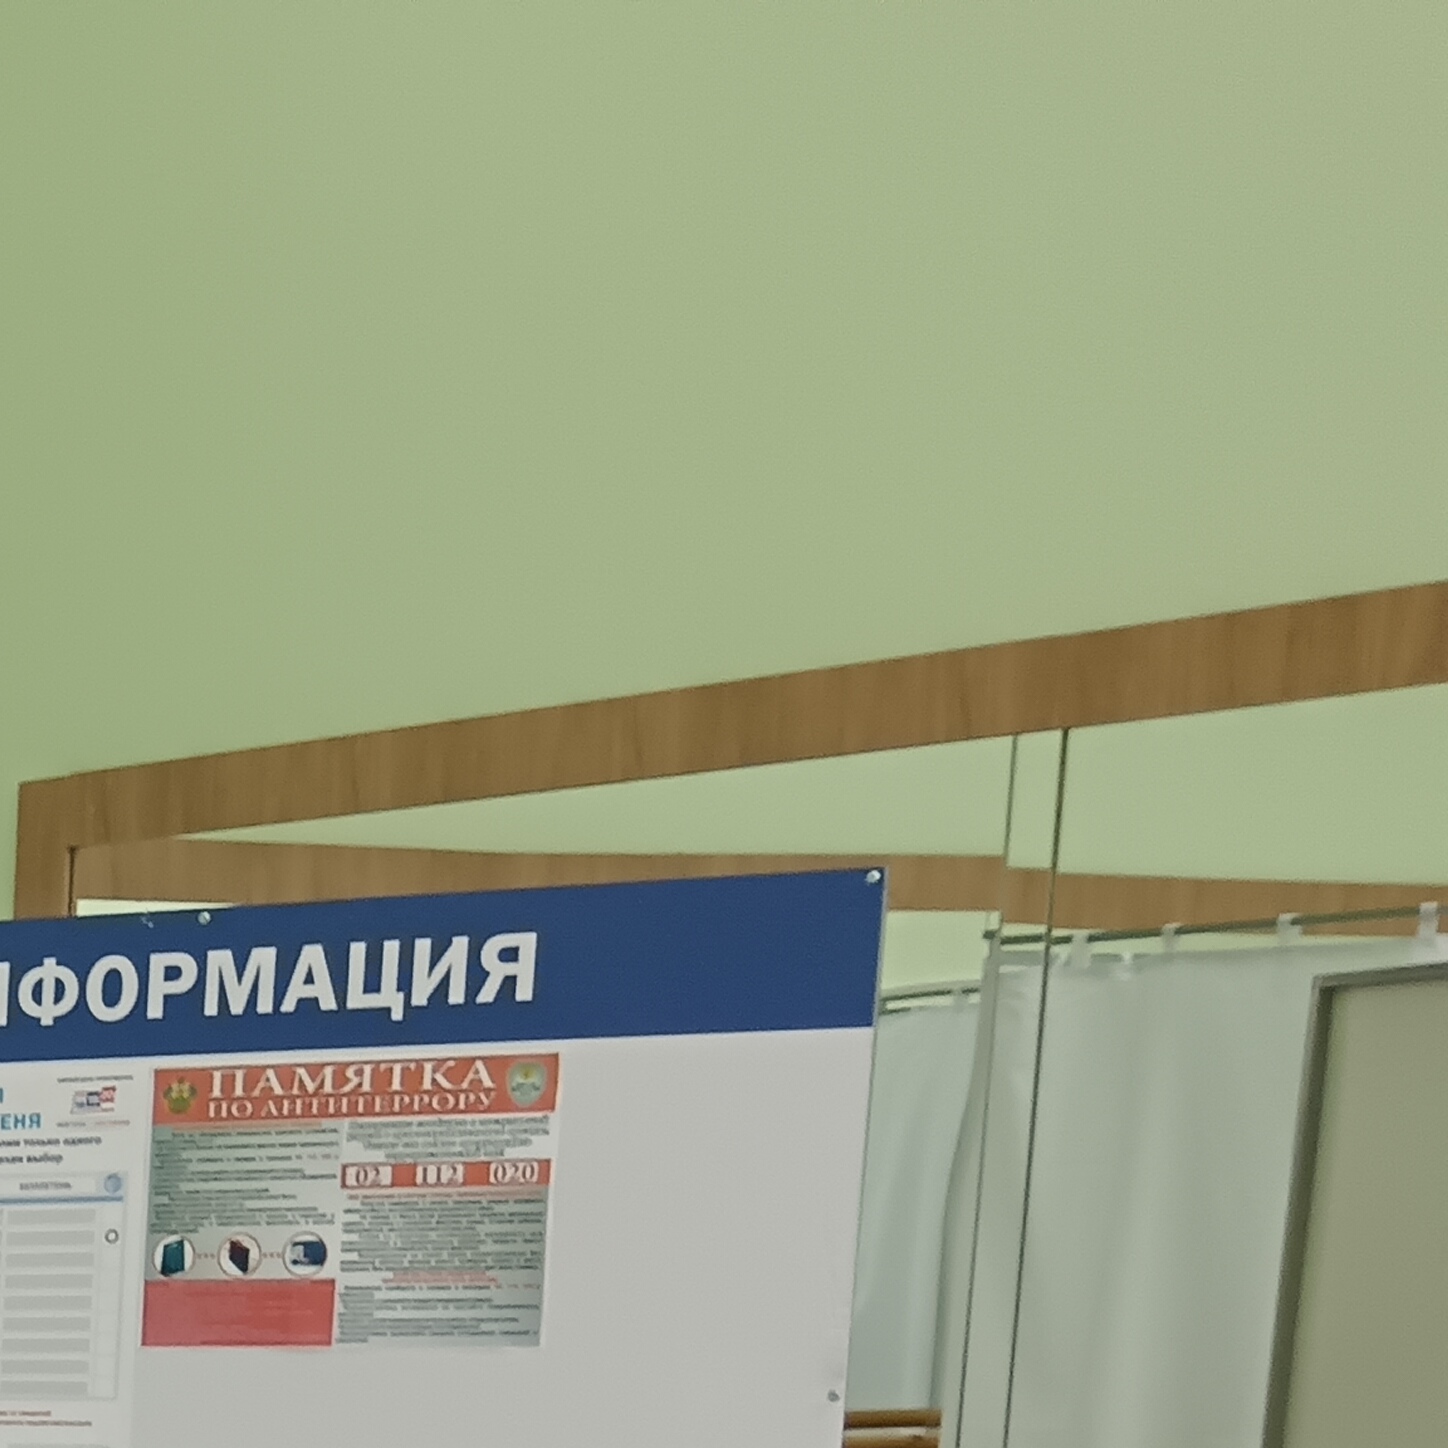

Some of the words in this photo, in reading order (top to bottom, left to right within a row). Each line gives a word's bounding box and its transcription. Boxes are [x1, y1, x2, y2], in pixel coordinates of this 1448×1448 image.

[208, 1059, 496, 1099] ПАМЯТКА
[208, 1098, 254, 1119] ПО
[260, 1091, 496, 1118] АНТИТЕРРОРУ
